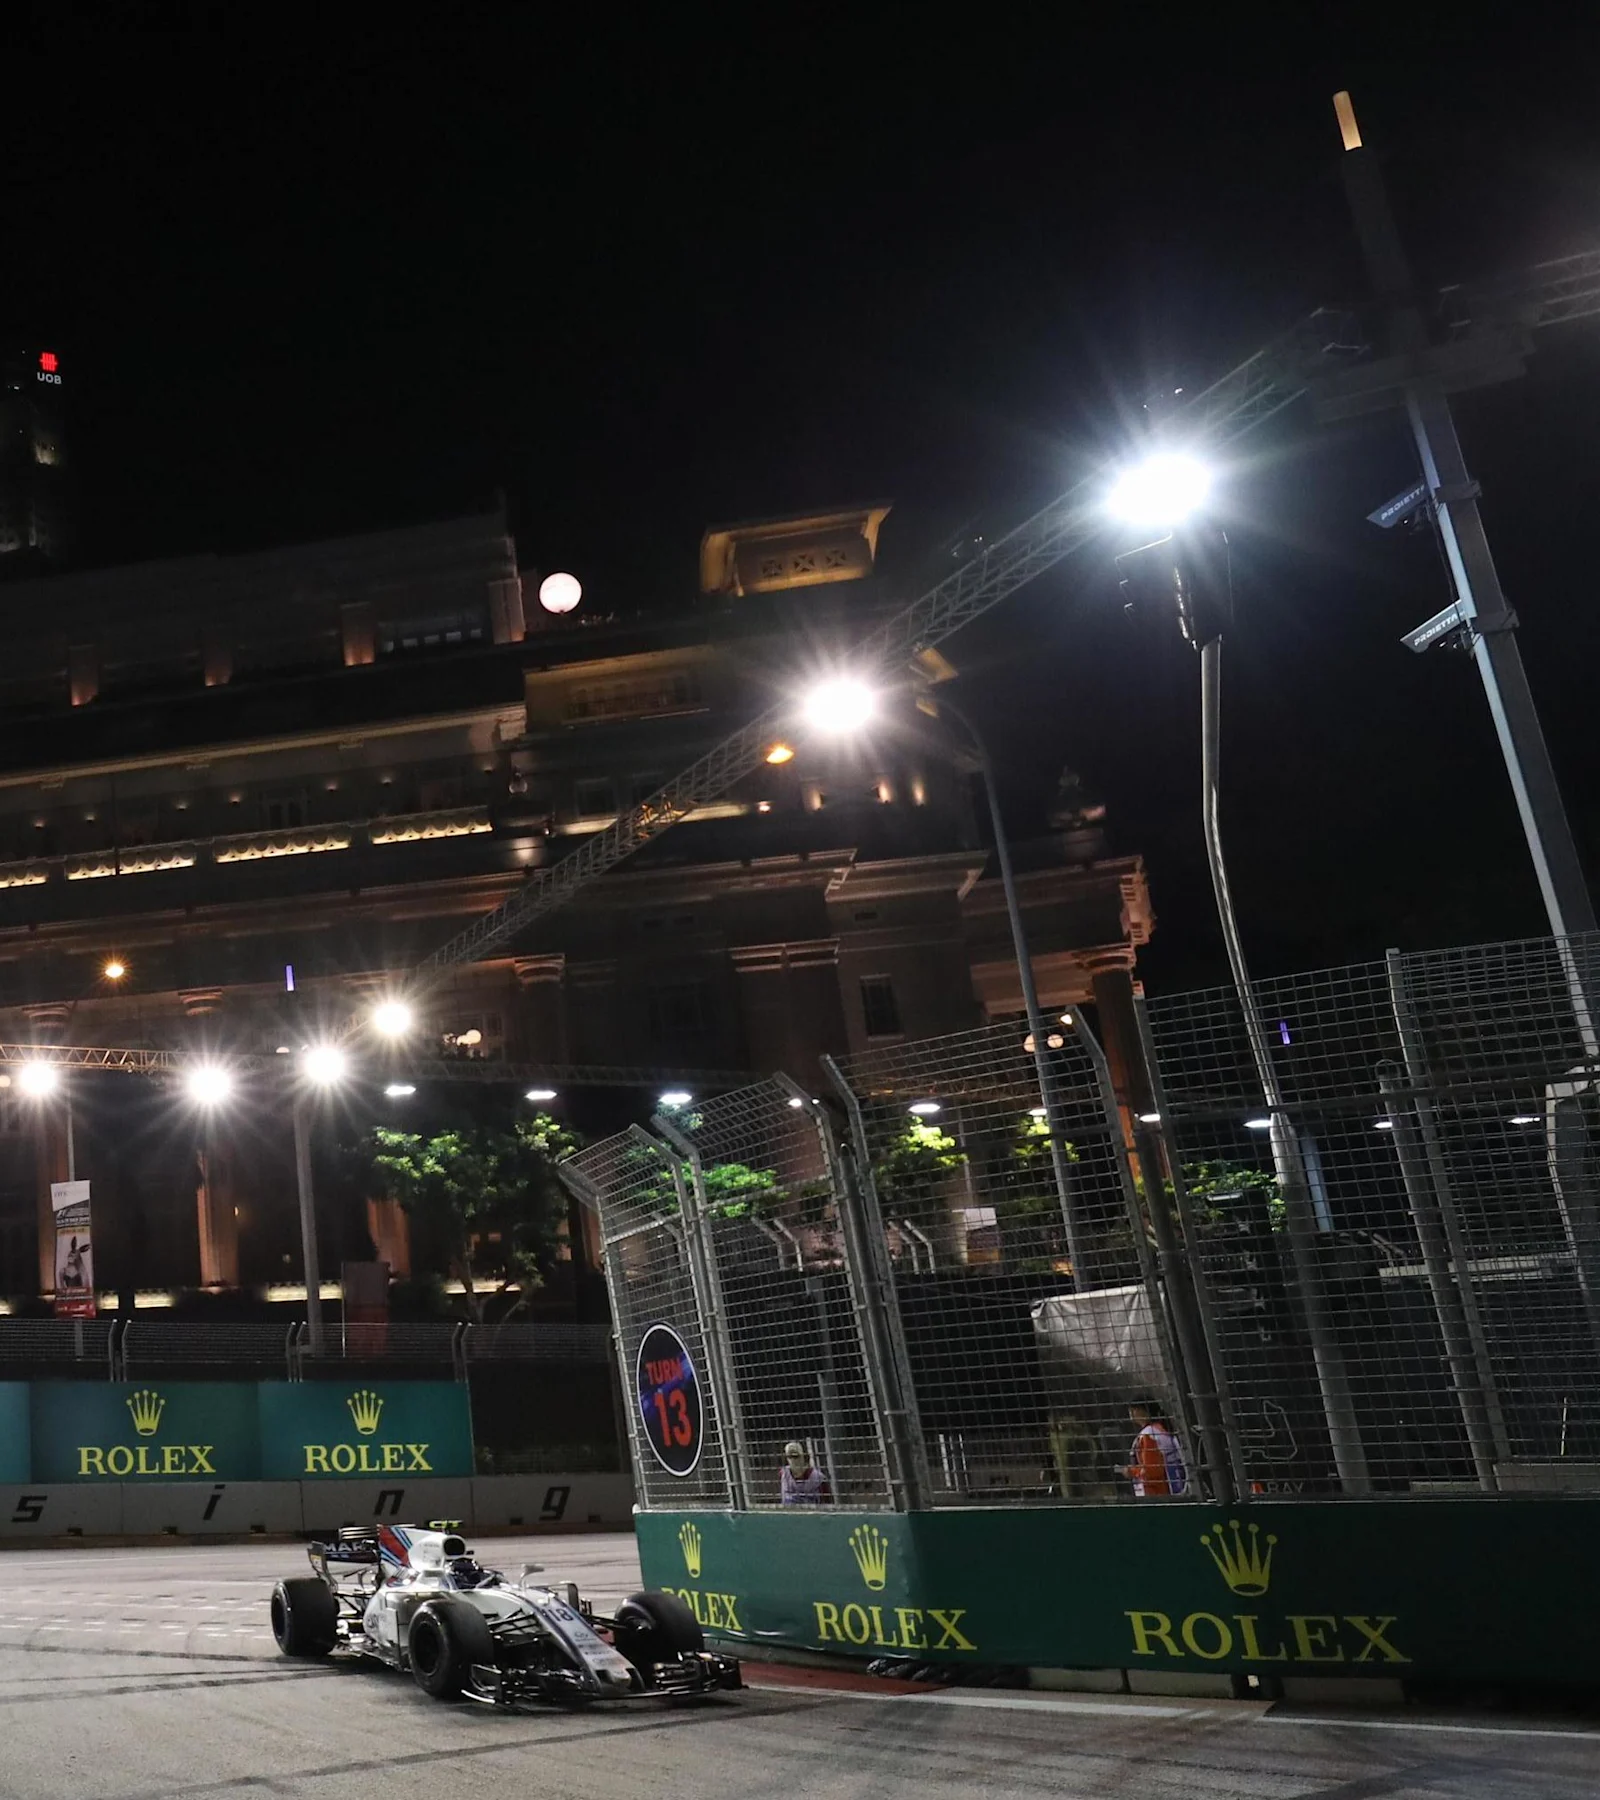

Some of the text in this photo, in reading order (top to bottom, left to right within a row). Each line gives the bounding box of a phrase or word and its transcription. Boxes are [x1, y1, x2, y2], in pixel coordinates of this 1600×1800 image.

[36, 371, 62, 385] UOB
[645, 1358, 683, 1385] TURN
[653, 1388, 692, 1448] 13
[78, 1445, 216, 1475] ROLEX
[303, 1443, 434, 1473] ROLEX
[660, 1586, 744, 1632] OLEX
[812, 1601, 977, 1651] ROLEX
[1124, 1610, 1413, 1664] ROLEX
